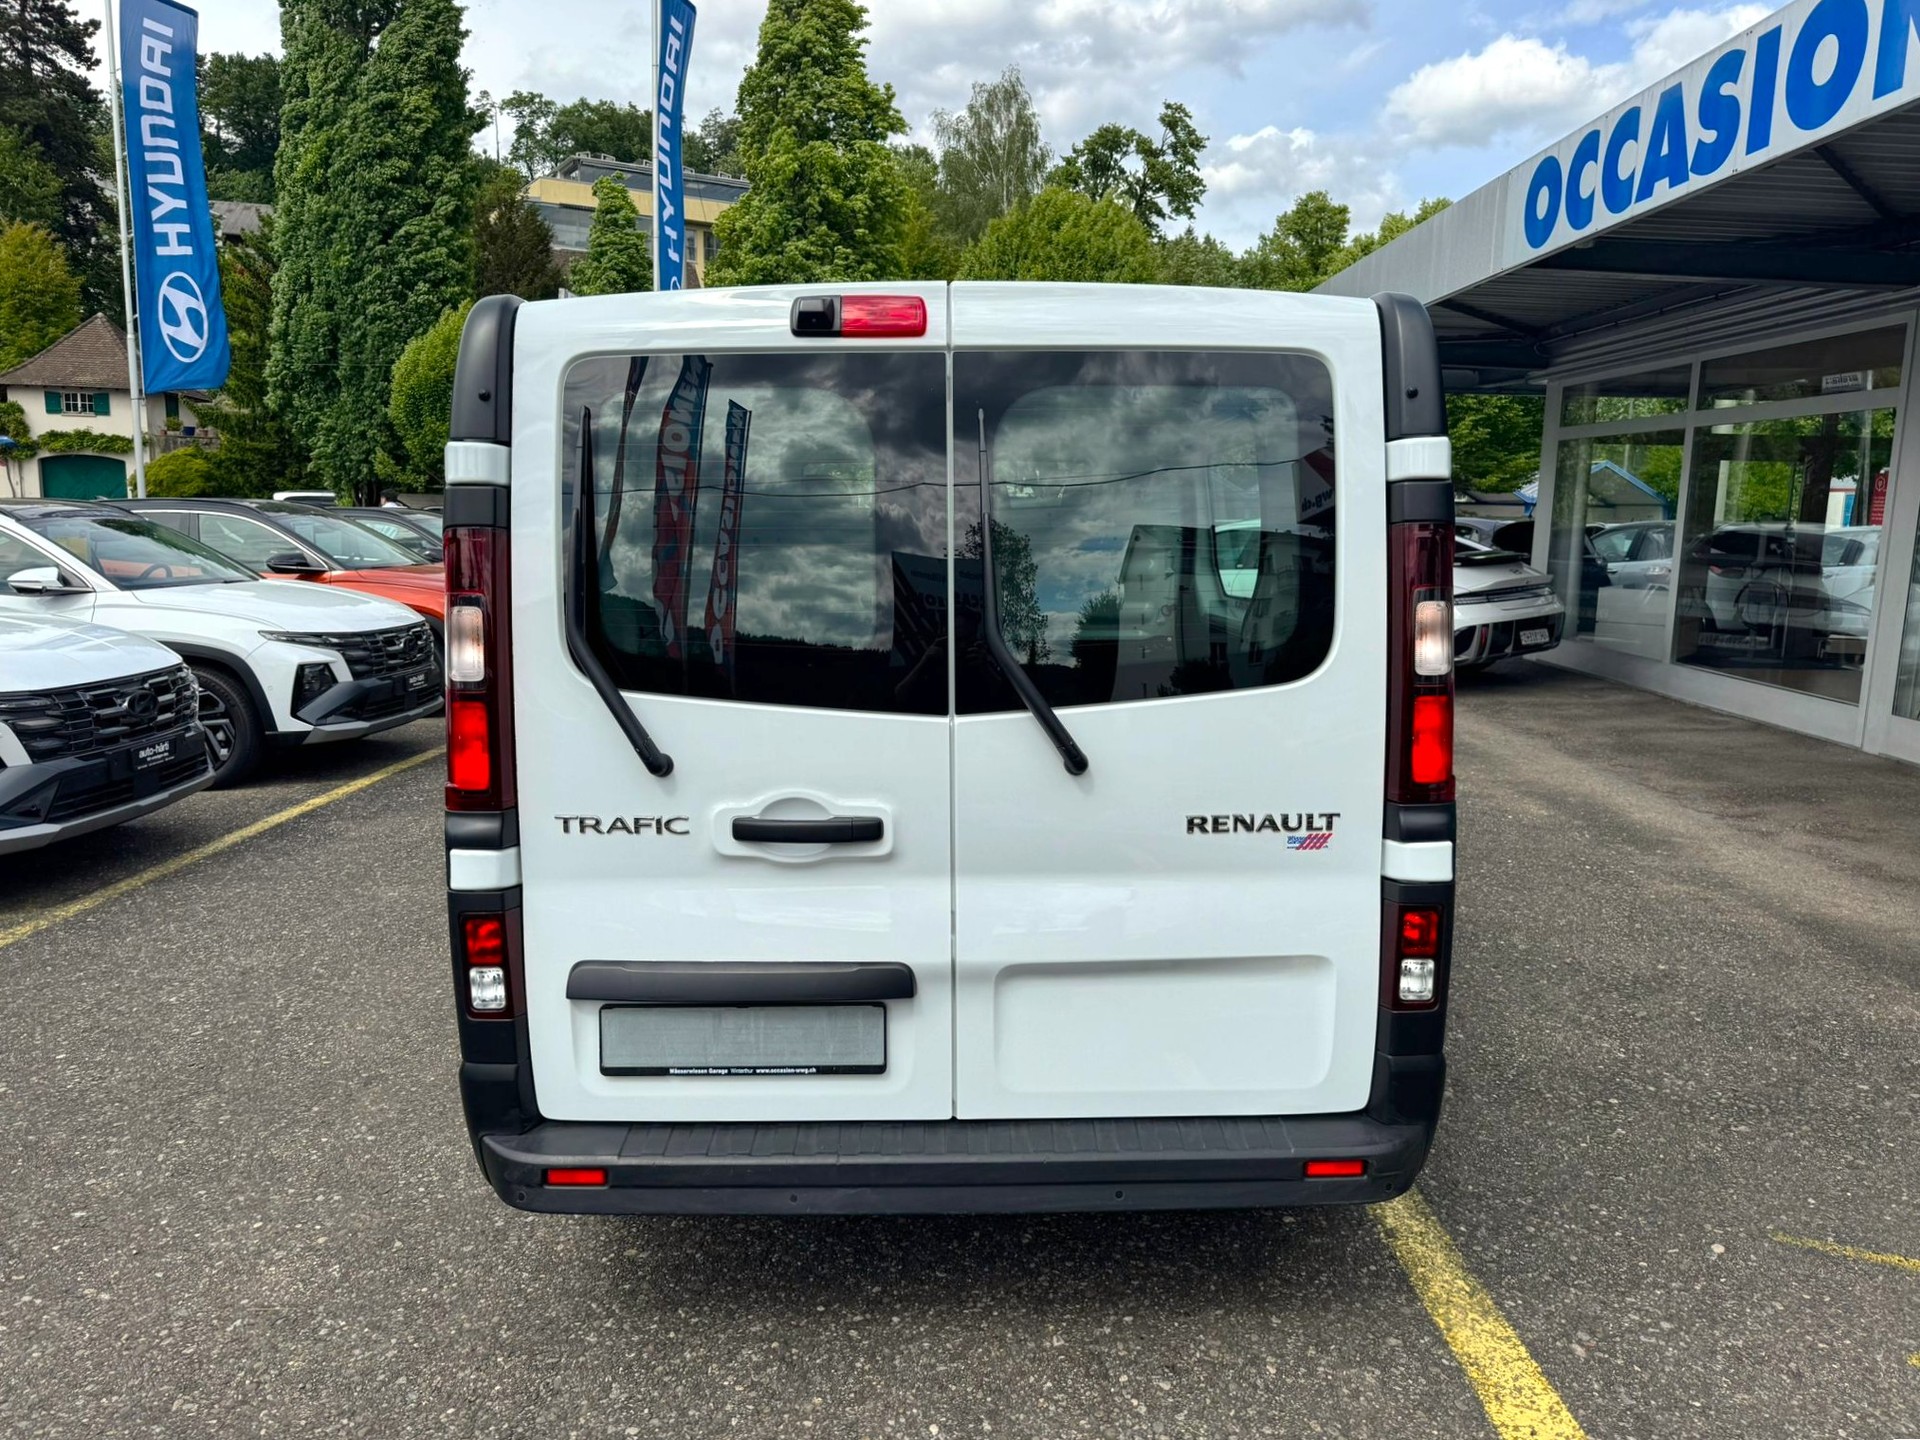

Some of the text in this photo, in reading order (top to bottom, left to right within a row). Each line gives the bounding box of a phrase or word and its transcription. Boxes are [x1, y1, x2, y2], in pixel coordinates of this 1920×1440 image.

[139, 17, 194, 257] HYUNDAI
[657, 14, 685, 263] HYUNDAI
[1524, 0, 1920, 250] OCCASION
[554, 814, 690, 835] TRAFIC
[1185, 812, 1341, 834] RENAULT
[708, 1067, 728, 1076] Garage
